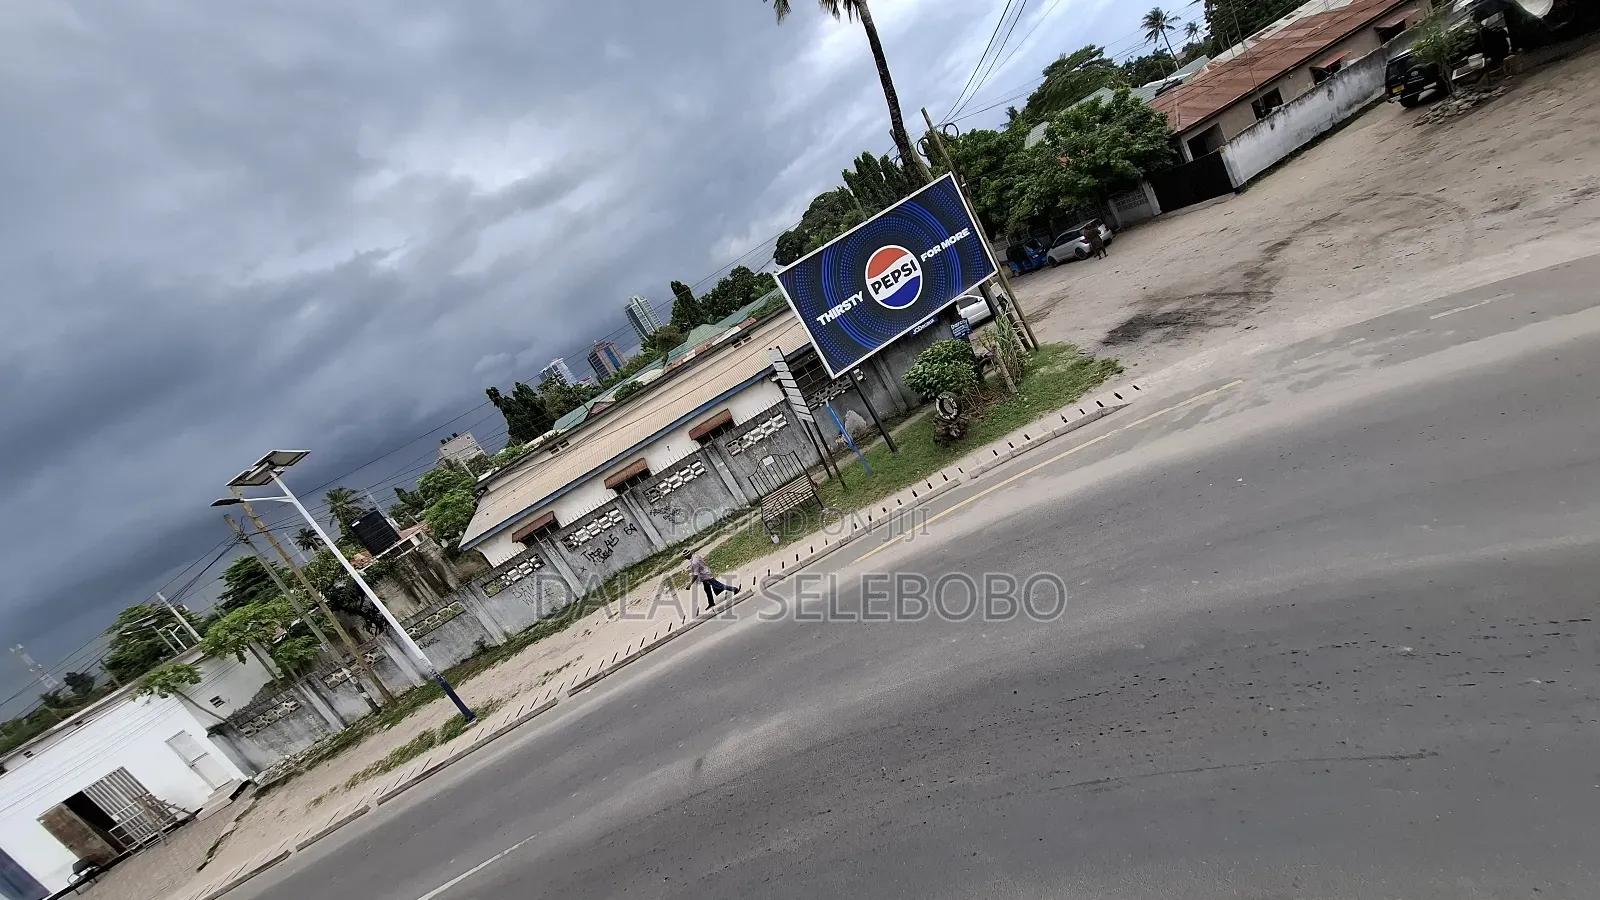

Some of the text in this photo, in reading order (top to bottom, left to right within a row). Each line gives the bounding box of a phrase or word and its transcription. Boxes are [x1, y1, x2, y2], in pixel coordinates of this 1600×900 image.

[816, 227, 971, 326] THIRSTY FOR MORE
[870, 259, 918, 296] PEPSI
